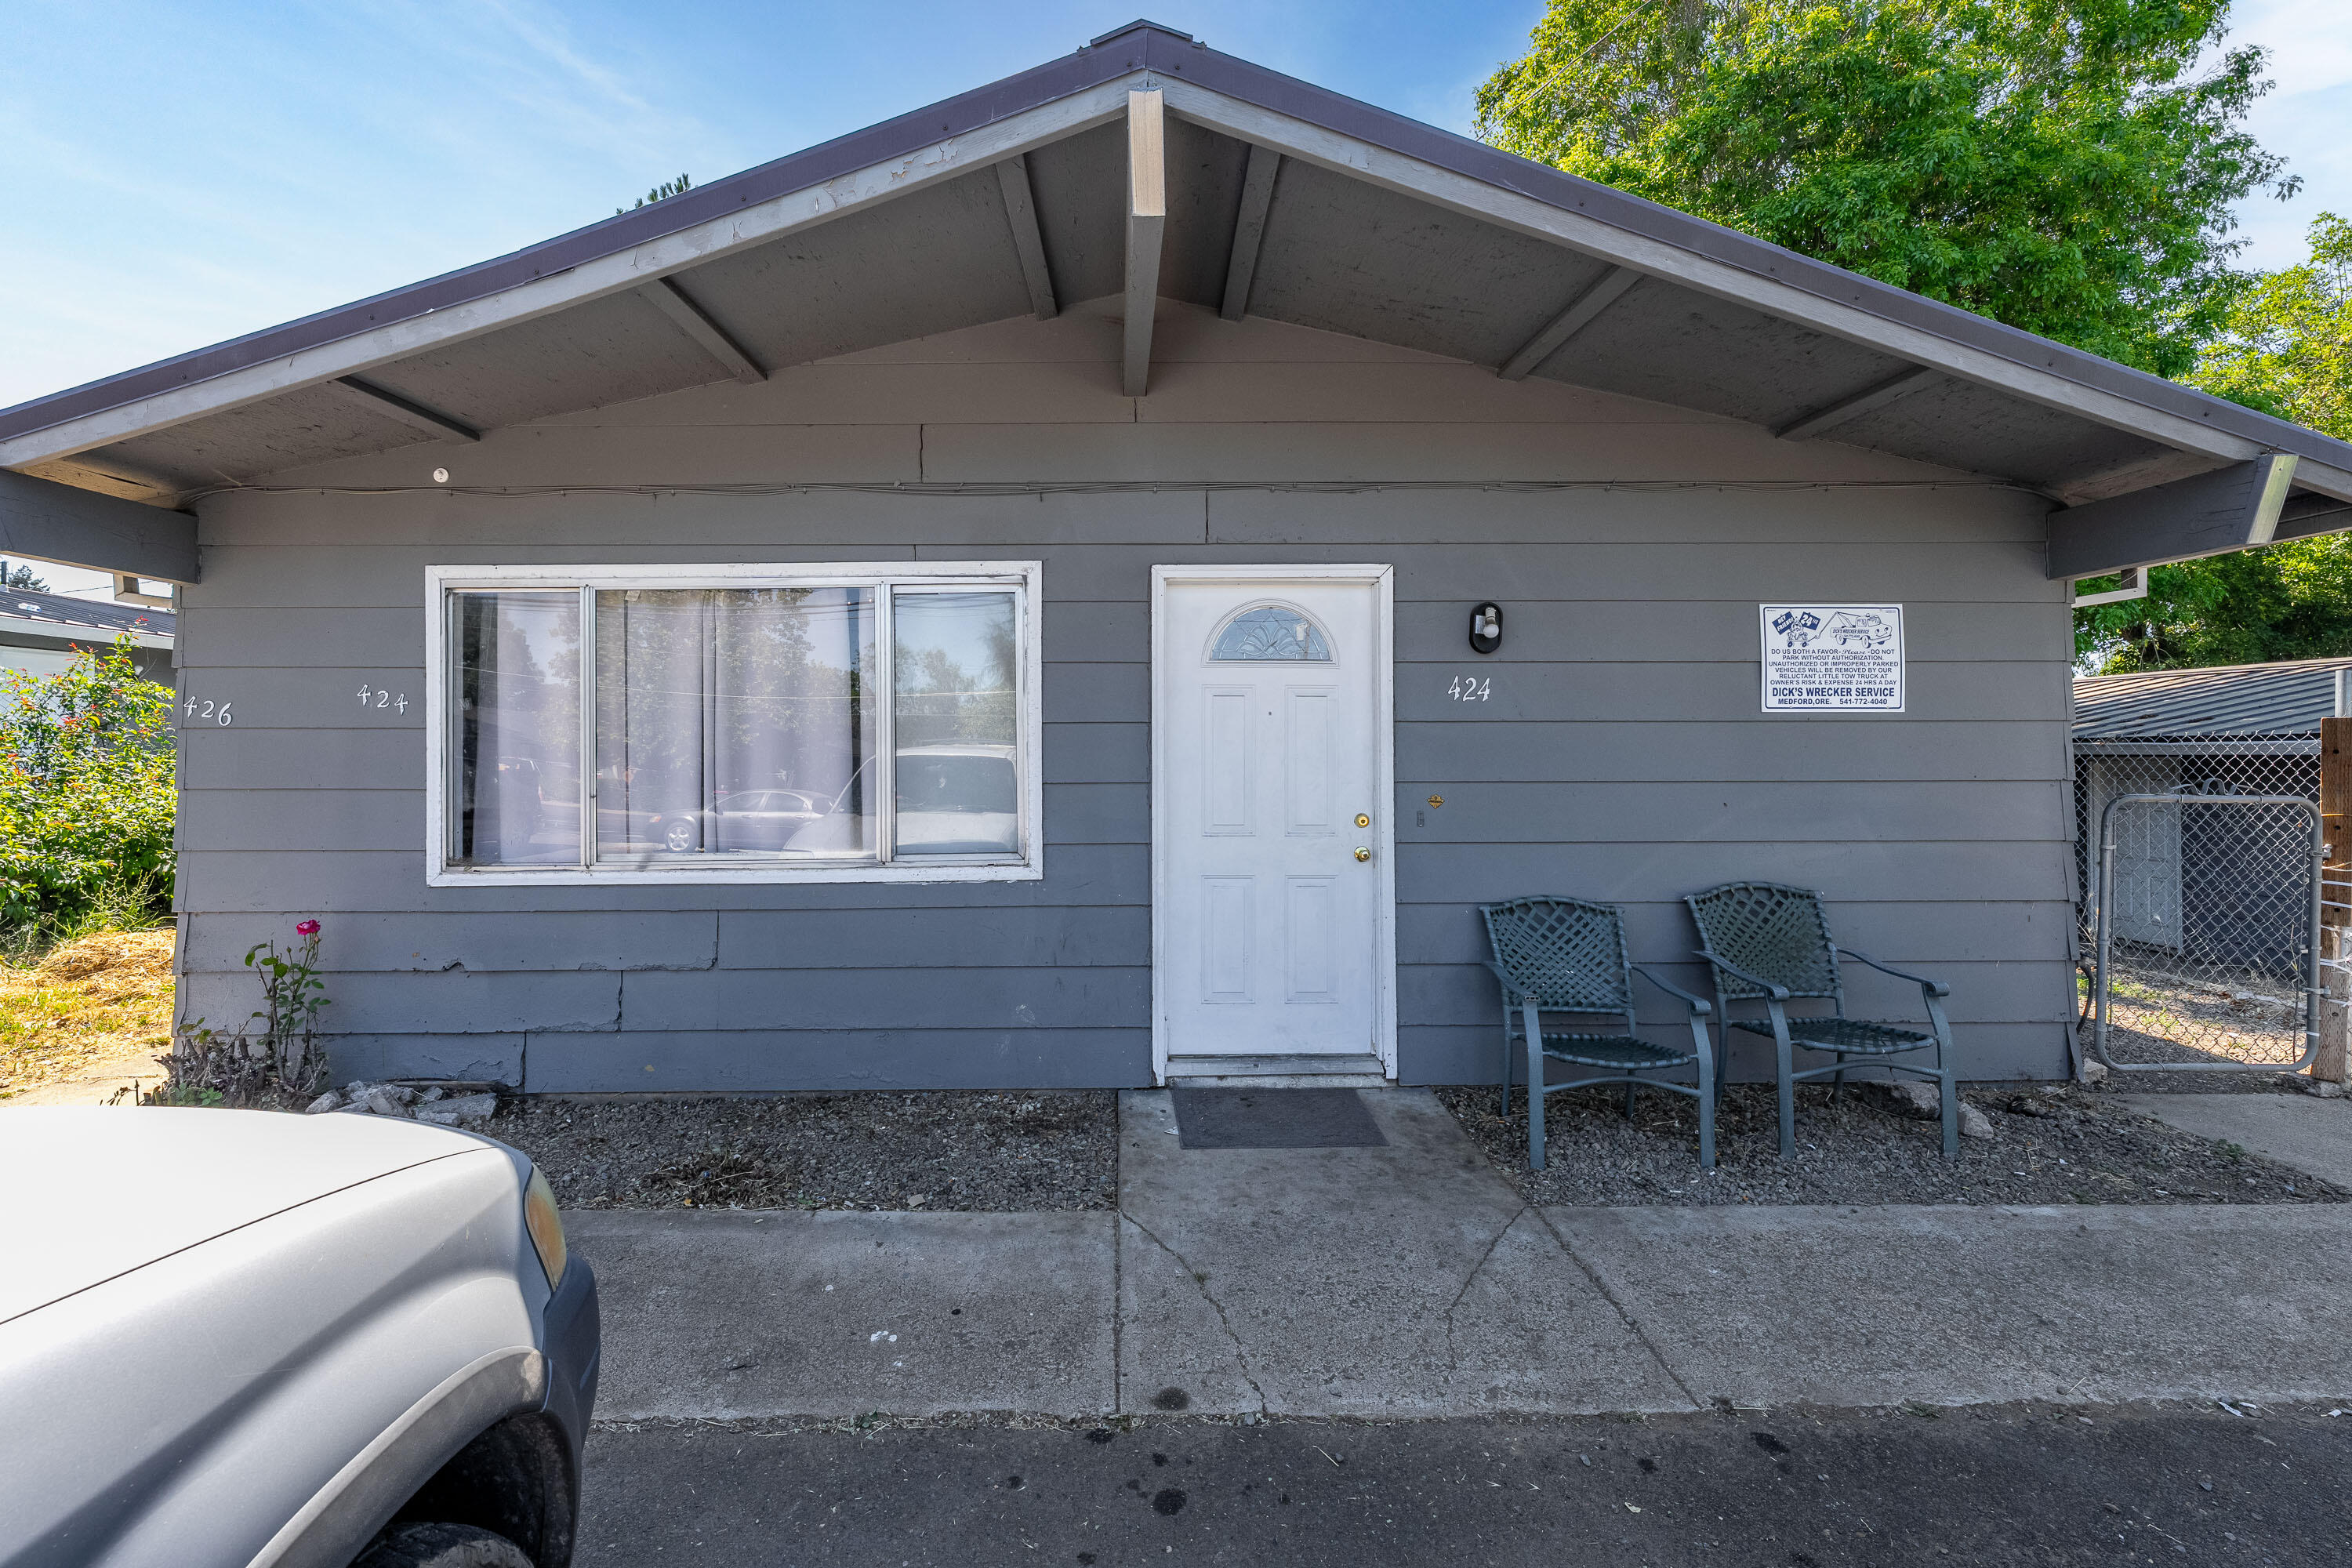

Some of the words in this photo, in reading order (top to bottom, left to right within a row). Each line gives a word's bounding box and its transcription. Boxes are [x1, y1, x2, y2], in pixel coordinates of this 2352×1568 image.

[1777, 615, 1786, 624] HEY
[1801, 615, 1813, 626] 24
[1447, 676, 1490, 702] 424
[1773, 688, 1802, 696] DICK'S
[1806, 688, 1852, 696] WRECKER
[1855, 688, 1894, 696] SERVICE
[358, 684, 408, 716] 424
[183, 695, 233, 727] 426
